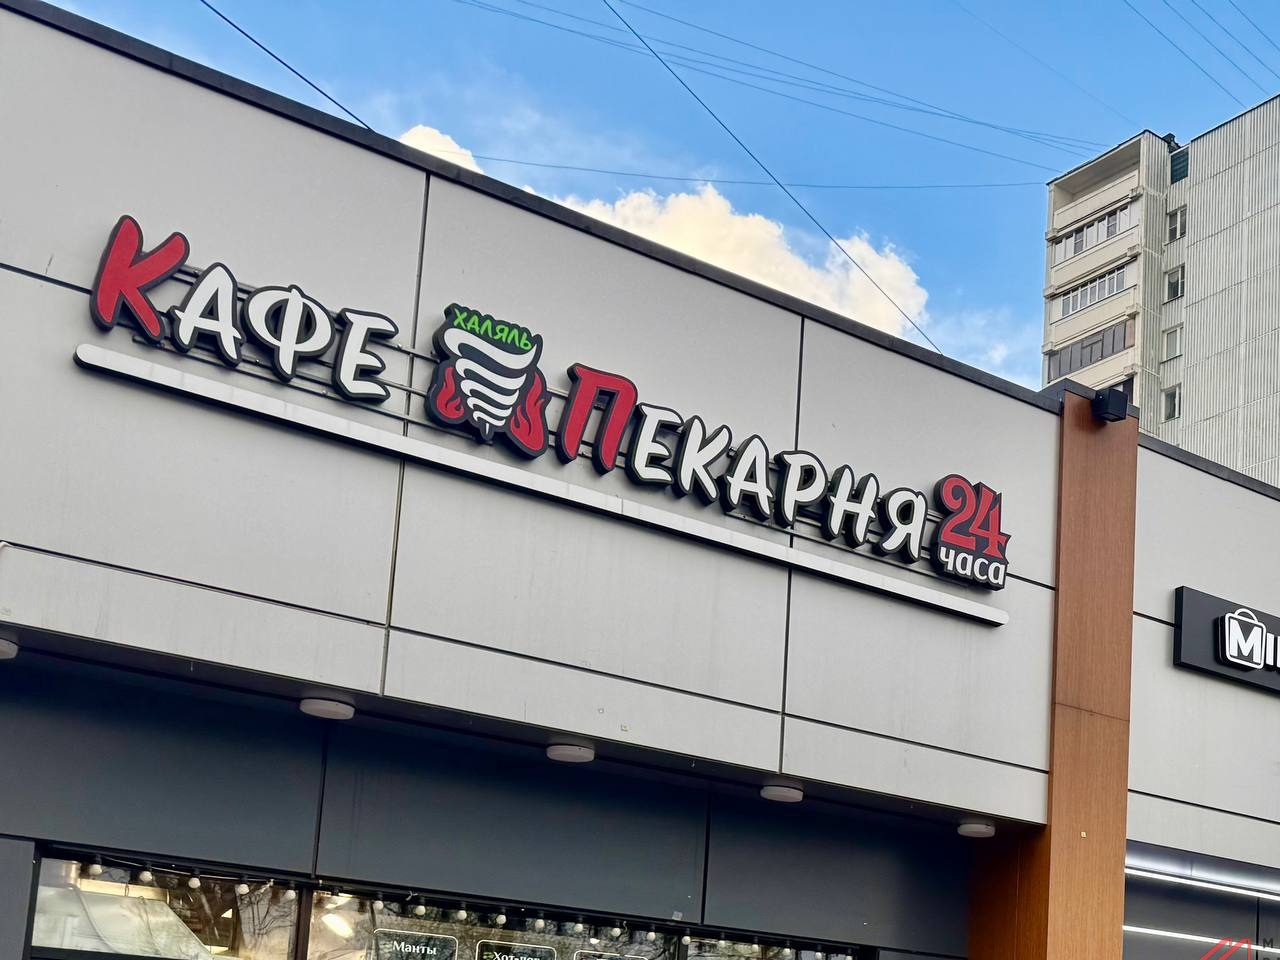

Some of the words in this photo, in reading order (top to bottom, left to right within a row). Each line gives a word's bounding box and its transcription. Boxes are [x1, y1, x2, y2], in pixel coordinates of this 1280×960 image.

[453, 308, 532, 351] ХАЛЯЛЬ
[91, 214, 398, 400] КАФЕ
[556, 363, 928, 563] ПЕКАРНЯ
[935, 474, 1010, 559] 24
[939, 545, 1006, 588] часа
[393, 940, 437, 956] Манты
